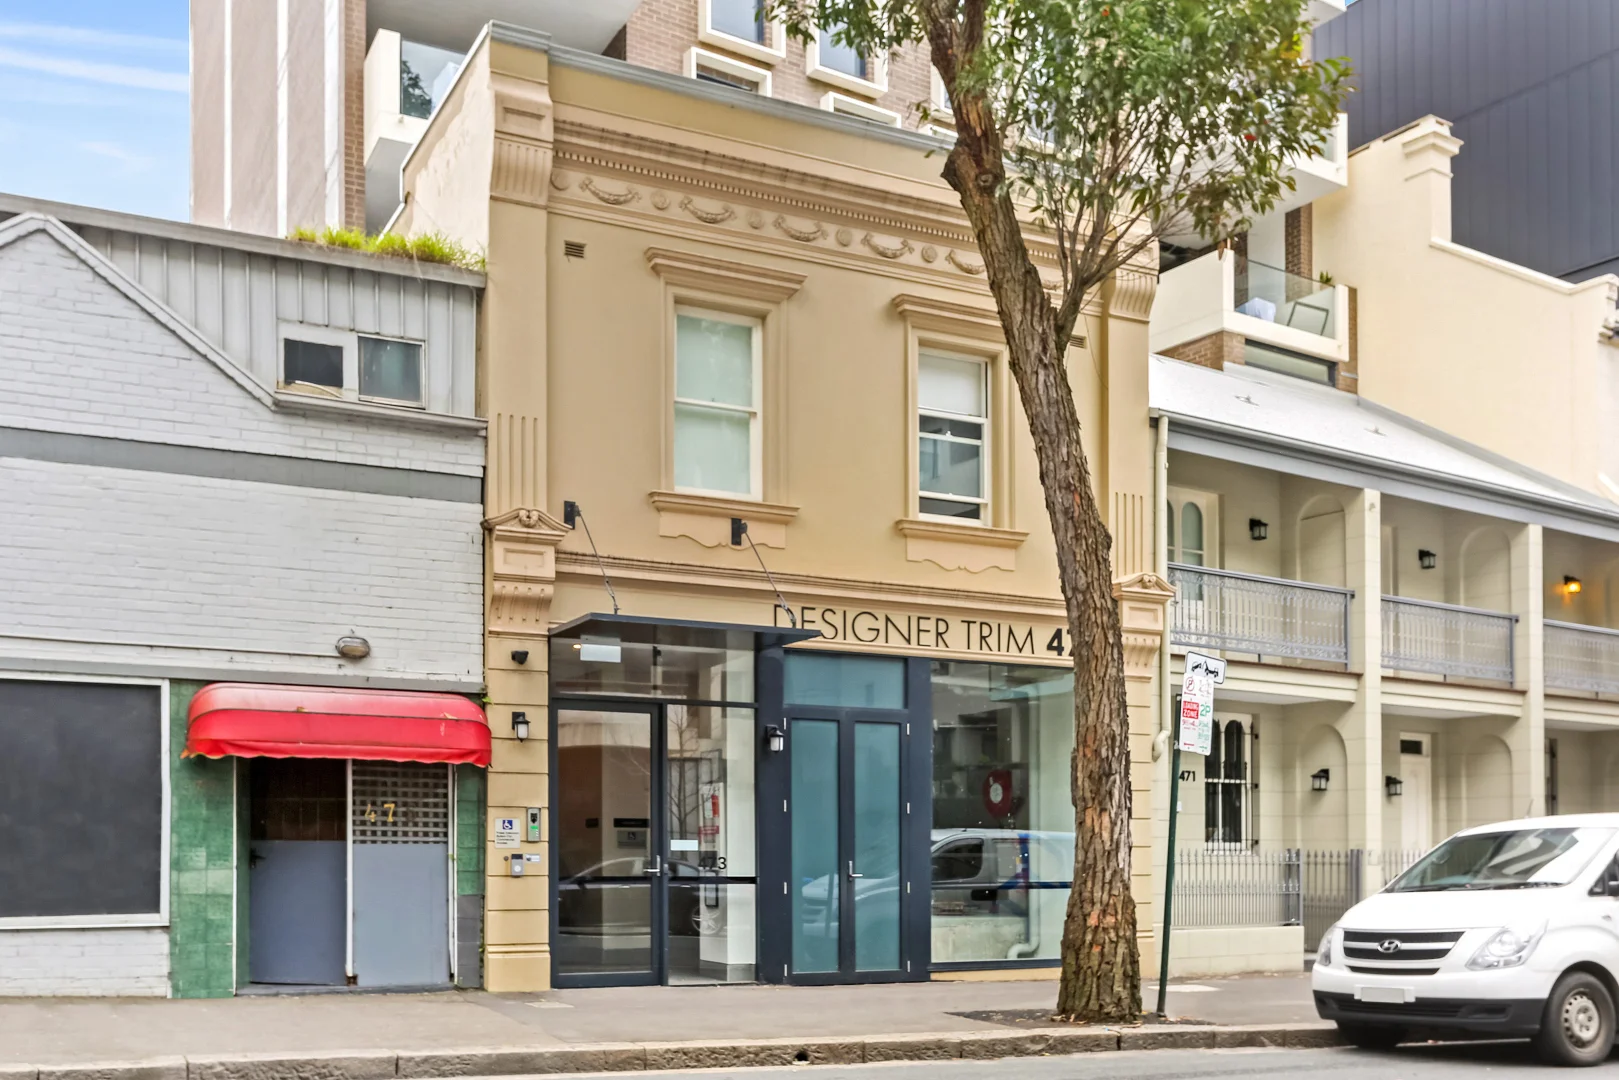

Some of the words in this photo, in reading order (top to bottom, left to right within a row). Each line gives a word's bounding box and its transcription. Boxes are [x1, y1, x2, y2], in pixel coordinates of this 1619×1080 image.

[774, 604, 949, 648] DESIGNER
[961, 619, 1035, 655] TRIM
[1199, 703, 1211, 717] 2P
[1179, 770, 1196, 782] 471
